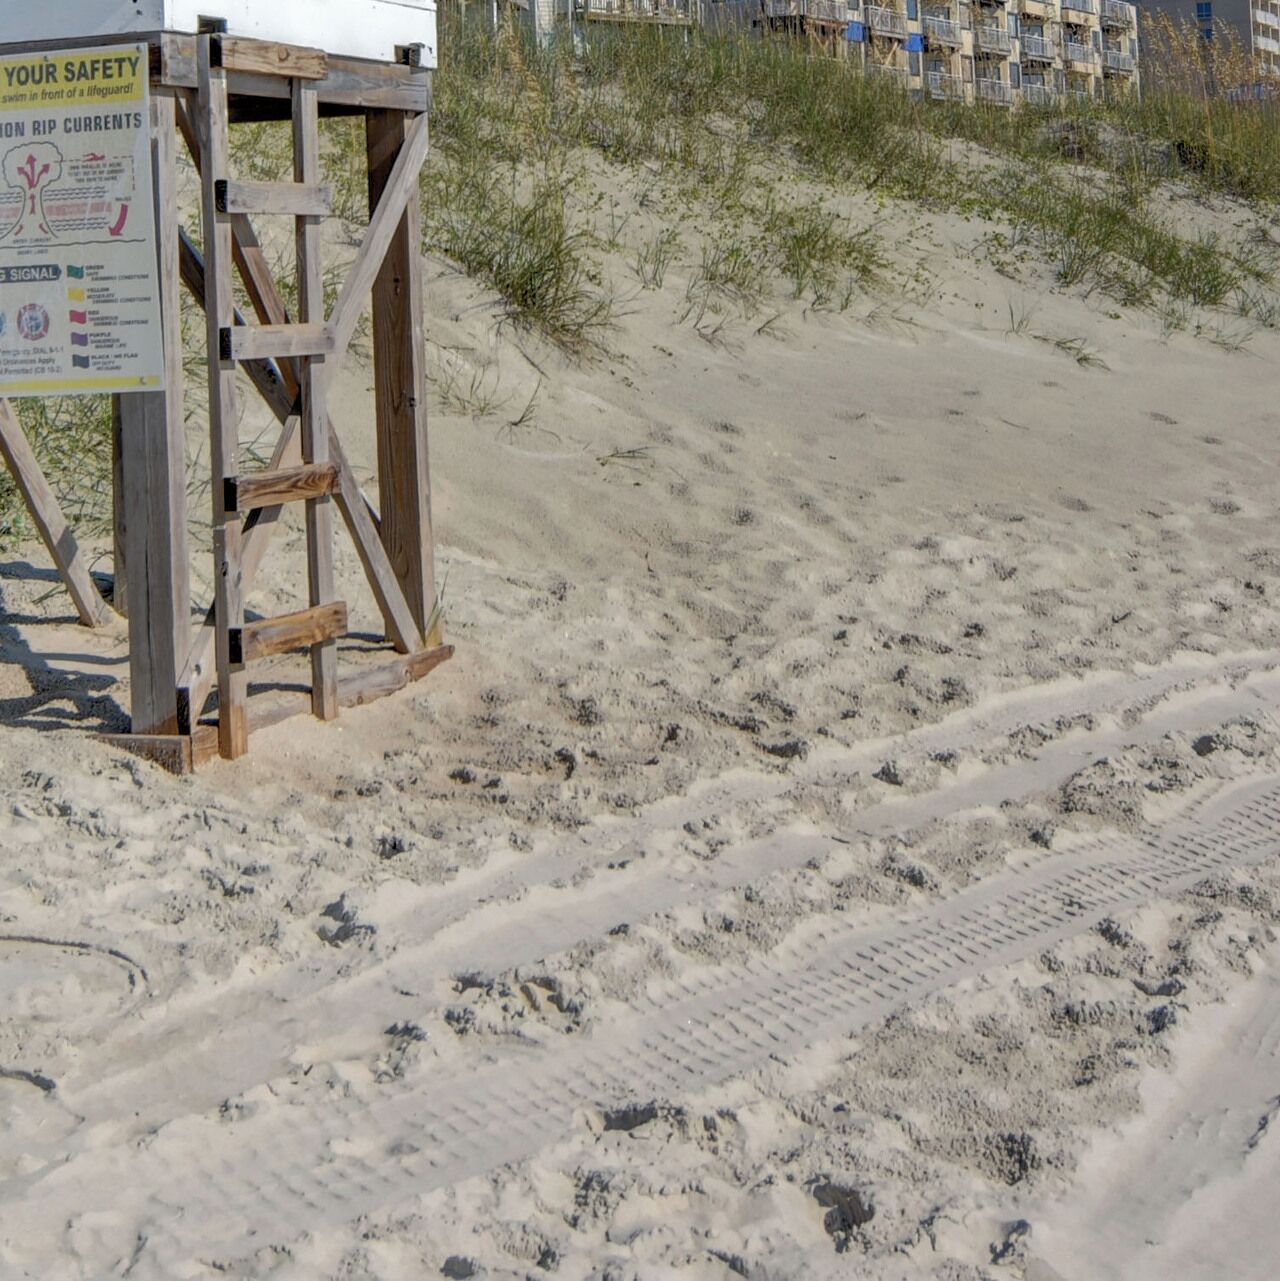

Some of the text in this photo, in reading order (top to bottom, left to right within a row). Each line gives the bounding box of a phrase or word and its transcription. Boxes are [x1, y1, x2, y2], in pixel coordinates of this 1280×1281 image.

[4, 63, 58, 87] YOUR
[64, 56, 140, 81] SAFETY
[1, 92, 27, 103] swim
[29, 90, 38, 101] in
[40, 88, 64, 101] front
[66, 86, 77, 98] of
[78, 88, 85, 97] a
[86, 82, 134, 99] lifeguard!
[32, 119, 57, 136] RIP
[63, 112, 142, 134] CURRENTS
[8, 266, 57, 281] SIGNAL
